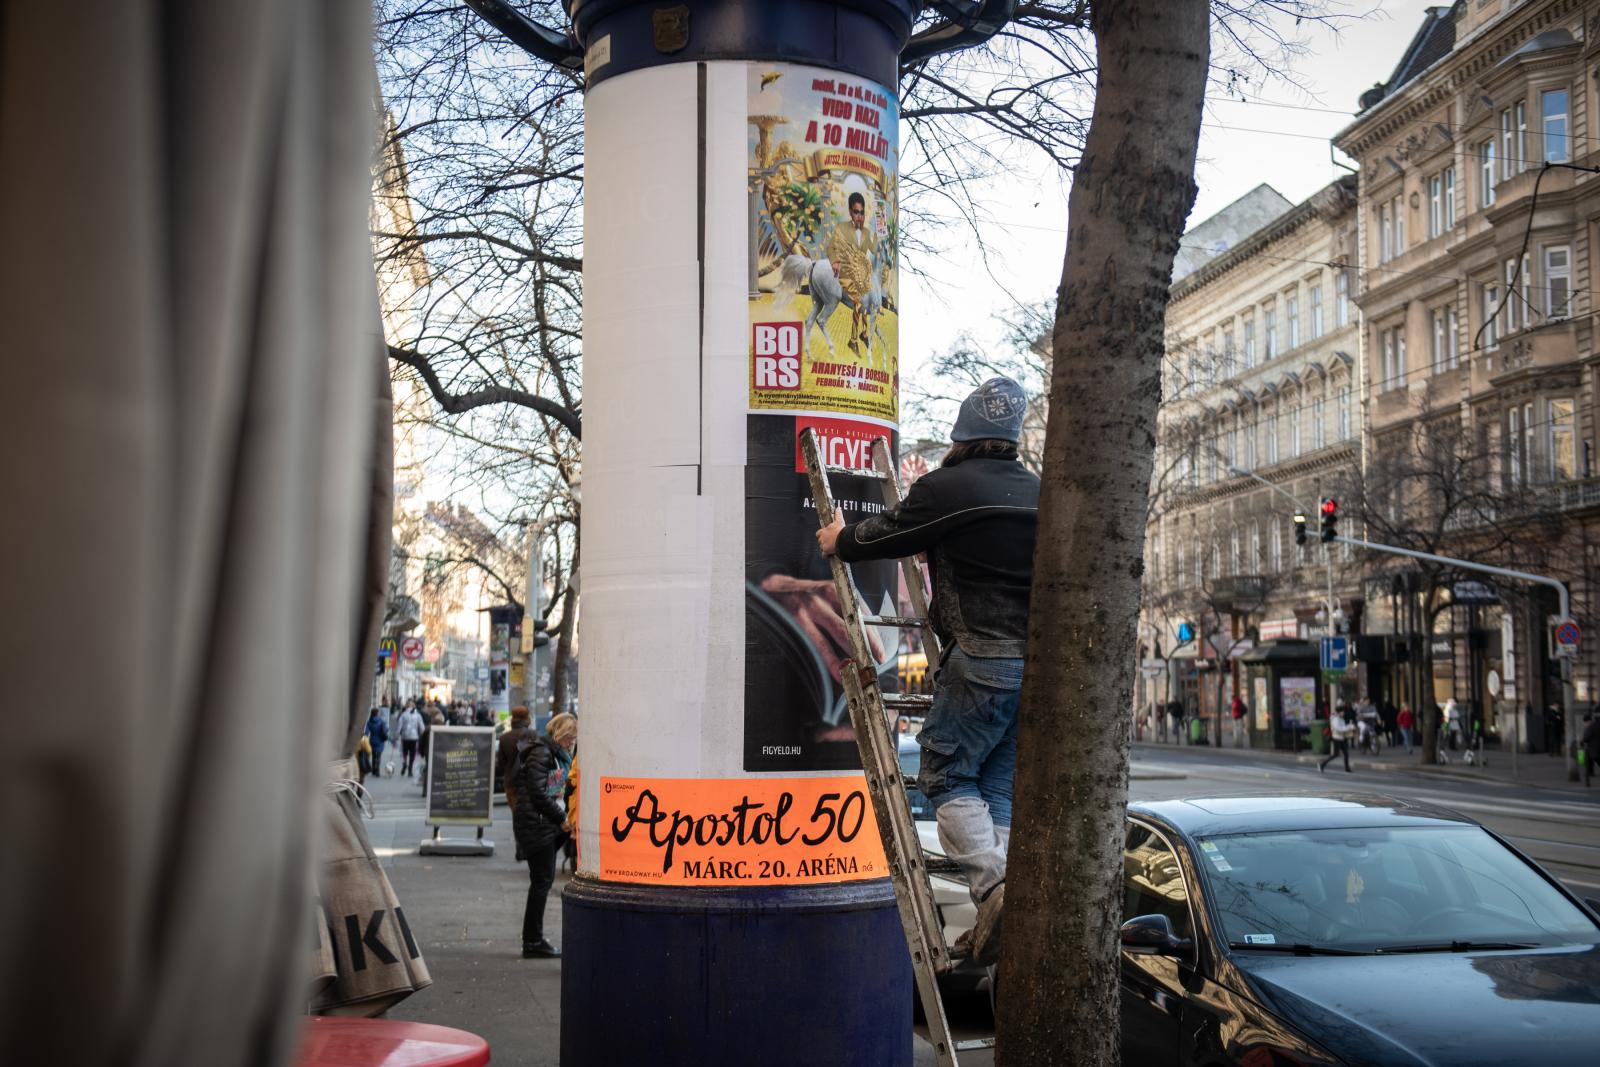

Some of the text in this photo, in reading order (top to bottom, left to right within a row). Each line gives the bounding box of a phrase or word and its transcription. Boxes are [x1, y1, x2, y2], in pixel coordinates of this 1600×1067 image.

[822, 97, 853, 120] VIDD
[855, 104, 880, 129] HAZA
[805, 121, 818, 143] A
[823, 123, 842, 146] 10
[755, 325, 799, 357] BO
[755, 357, 799, 387] RS
[811, 361, 889, 384] ARANYESŐ A BORSBAN
[816, 376, 844, 388] FEBRUÁR
[858, 381, 878, 393] MÁRCIUS
[762, 745, 801, 756] FIGYELO.HU
[612, 789, 866, 874] Apostol 50
[683, 853, 859, 879] MÁRC. 20. ARÉNA
